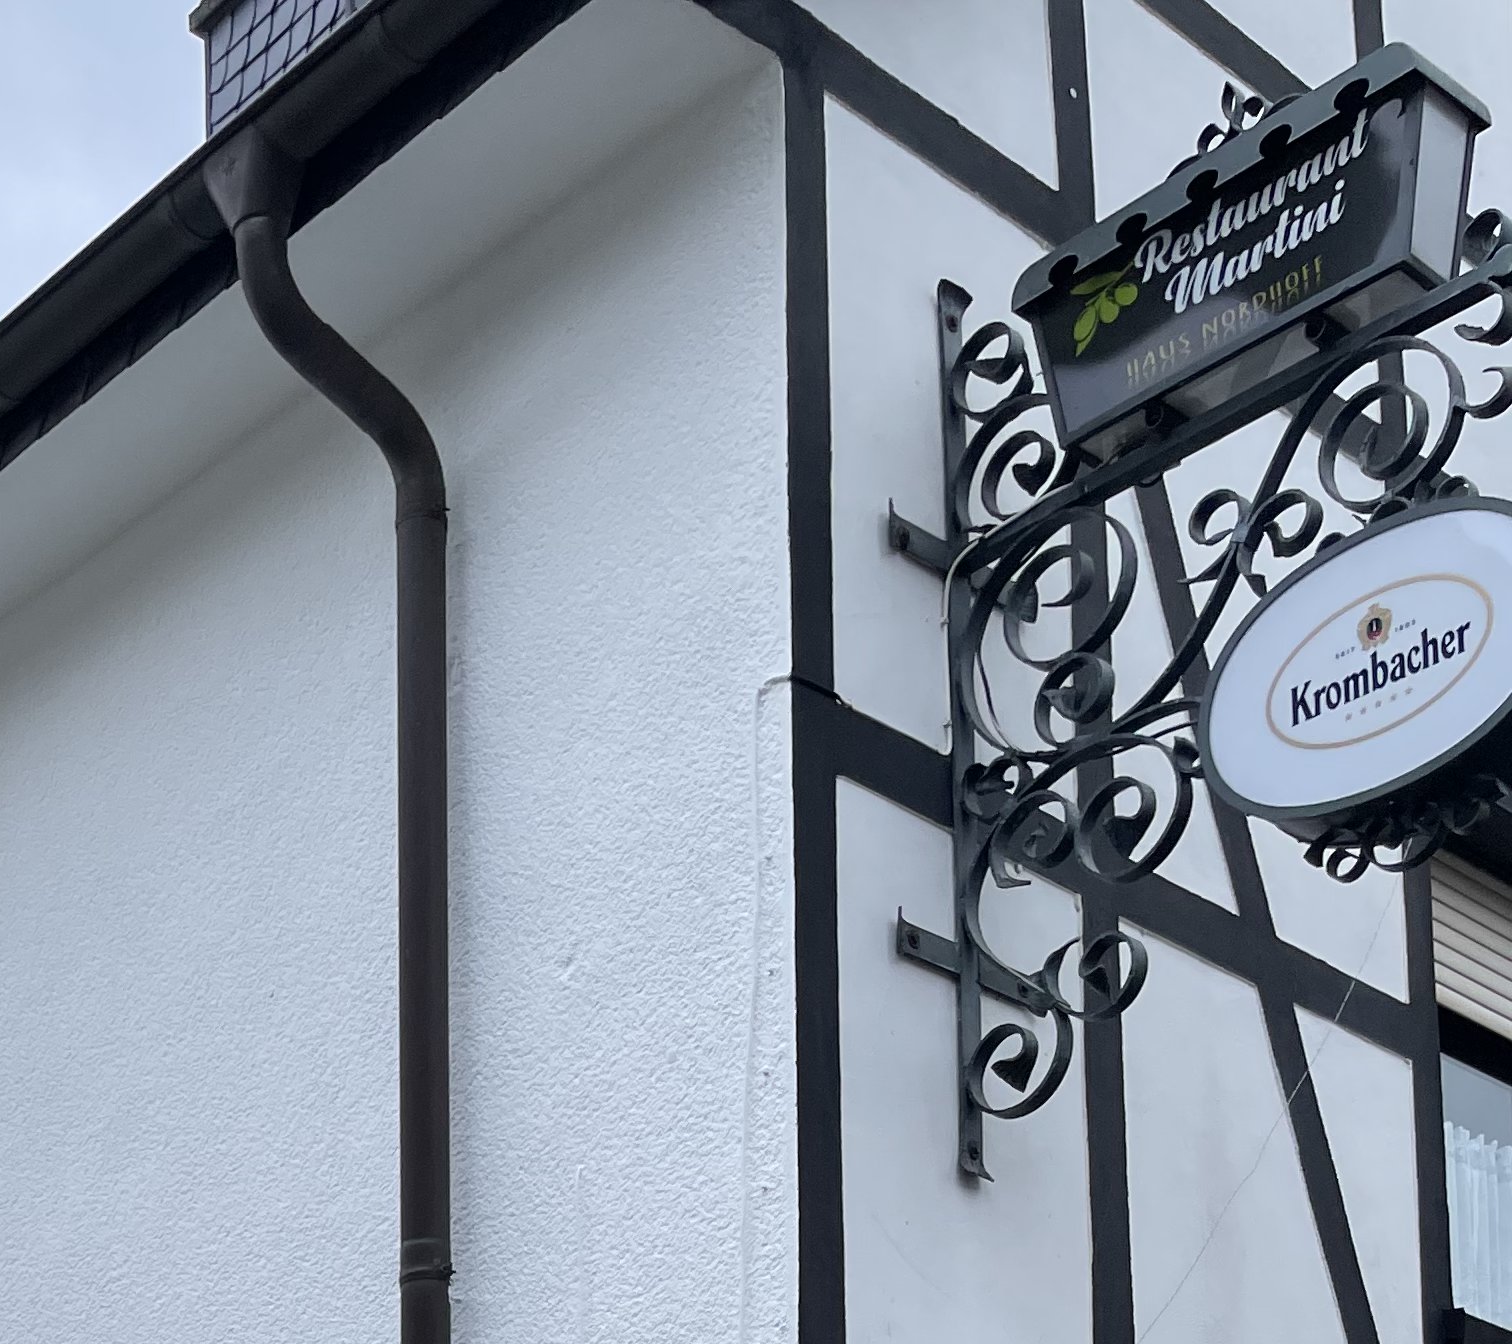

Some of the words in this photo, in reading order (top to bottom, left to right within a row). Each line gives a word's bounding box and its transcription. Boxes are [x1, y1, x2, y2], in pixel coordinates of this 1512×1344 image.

[1133, 107, 1369, 284] Restaurant
[1164, 178, 1346, 314] Martini
[1126, 333, 1191, 378] HAUS
[1291, 621, 1471, 728] Krombacher
